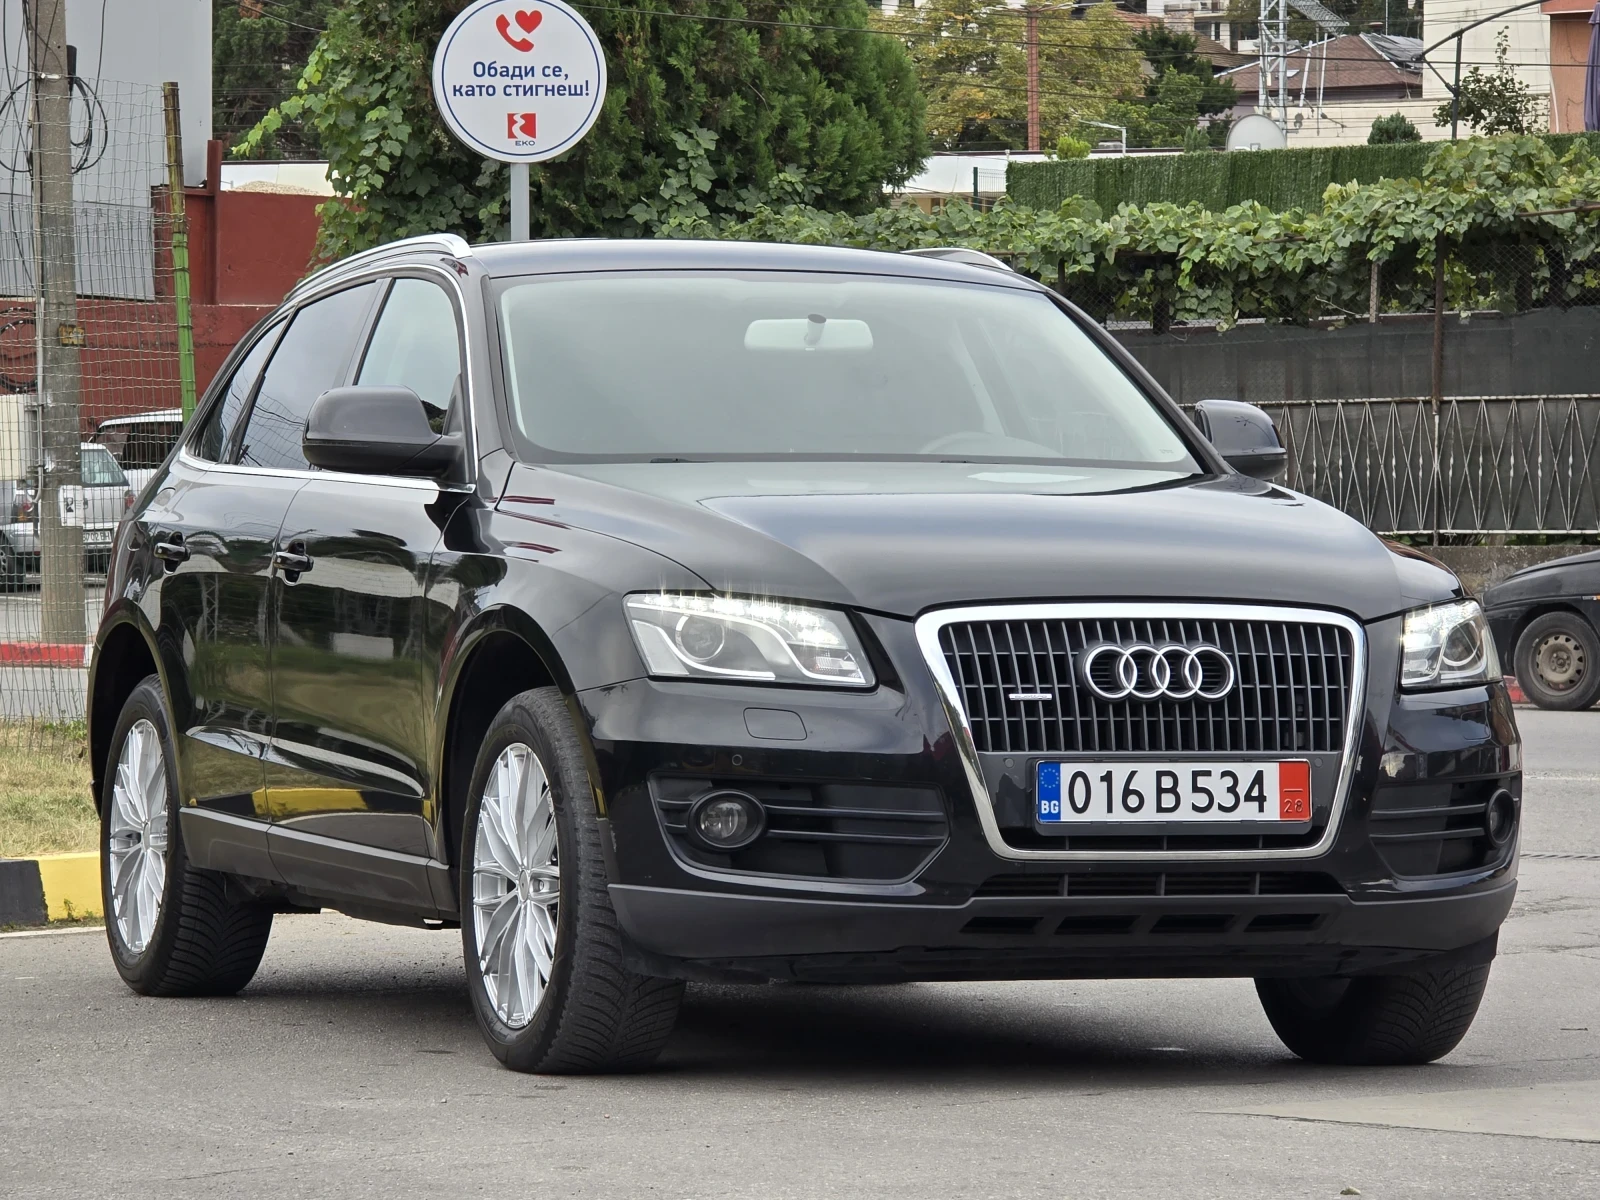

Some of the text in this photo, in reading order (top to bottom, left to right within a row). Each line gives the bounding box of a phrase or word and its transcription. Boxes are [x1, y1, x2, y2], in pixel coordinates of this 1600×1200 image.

[473, 60, 569, 80] Обади се,
[452, 80, 590, 97] като стигнеш!
[1041, 800, 1059, 814] BG
[1283, 798, 1304, 813] 28
